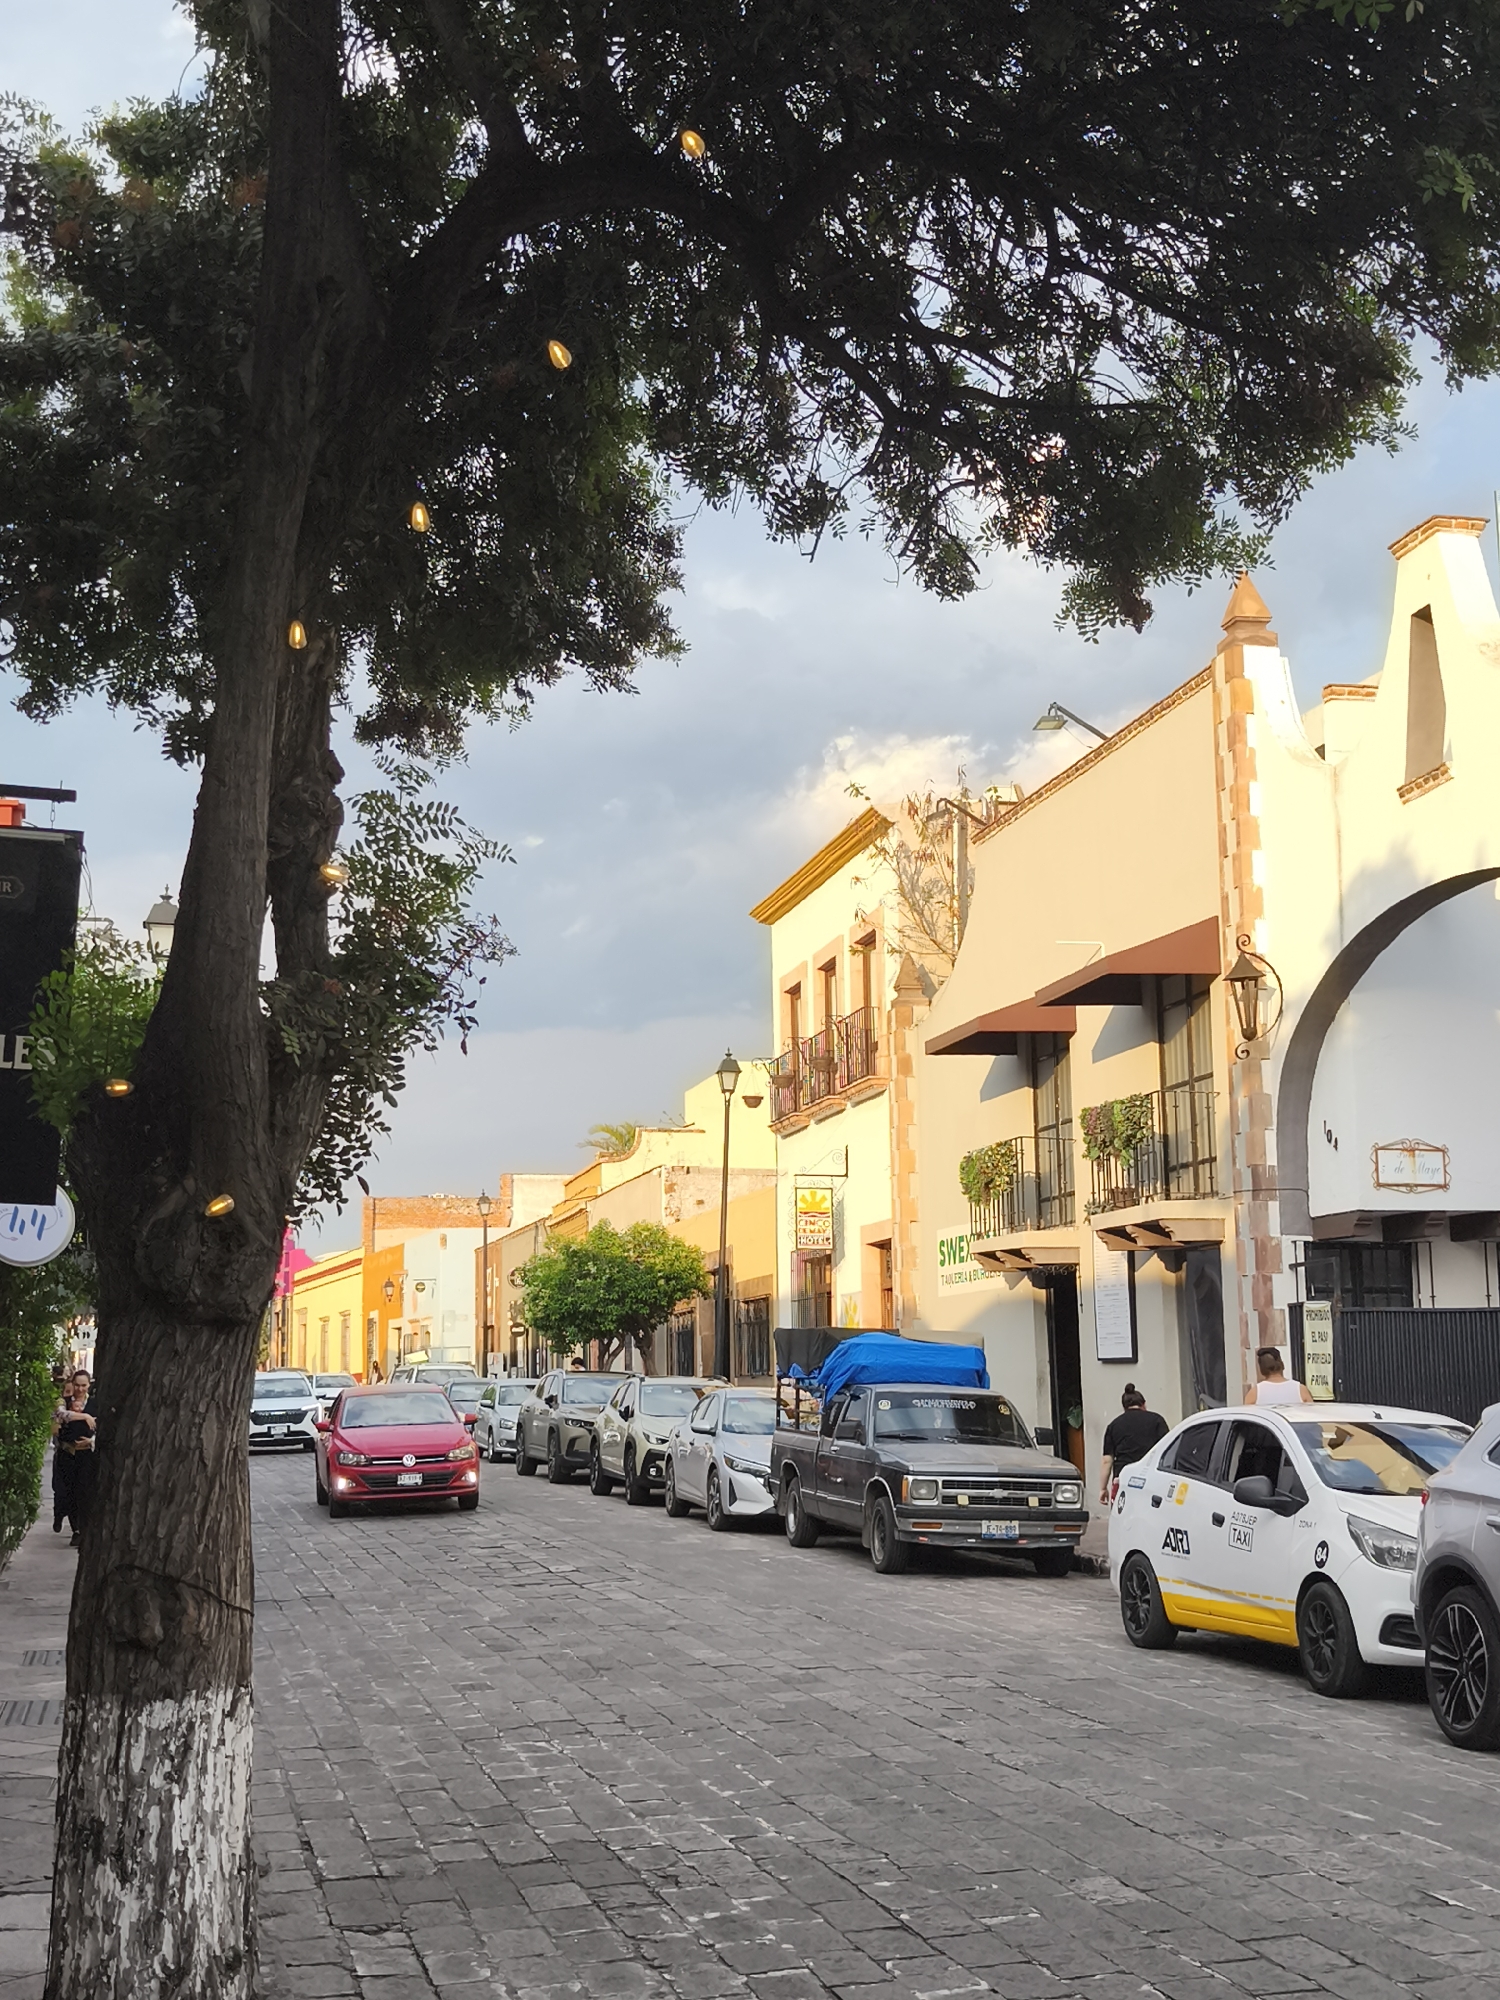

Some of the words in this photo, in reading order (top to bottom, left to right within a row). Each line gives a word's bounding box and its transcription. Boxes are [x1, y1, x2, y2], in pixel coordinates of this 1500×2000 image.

[1323, 1120, 1339, 1152] 104
[1394, 1160, 1405, 1174] de
[1411, 1161, 1442, 1180] Mayo
[798, 1219, 831, 1228] CINCO
[799, 1235, 831, 1246] HOTEL
[1311, 1331, 1318, 1343] EL
[1318, 1331, 1328, 1342] PASO
[1232, 1527, 1251, 1547] TAXI
[1316, 1546, 1327, 1562] 84
